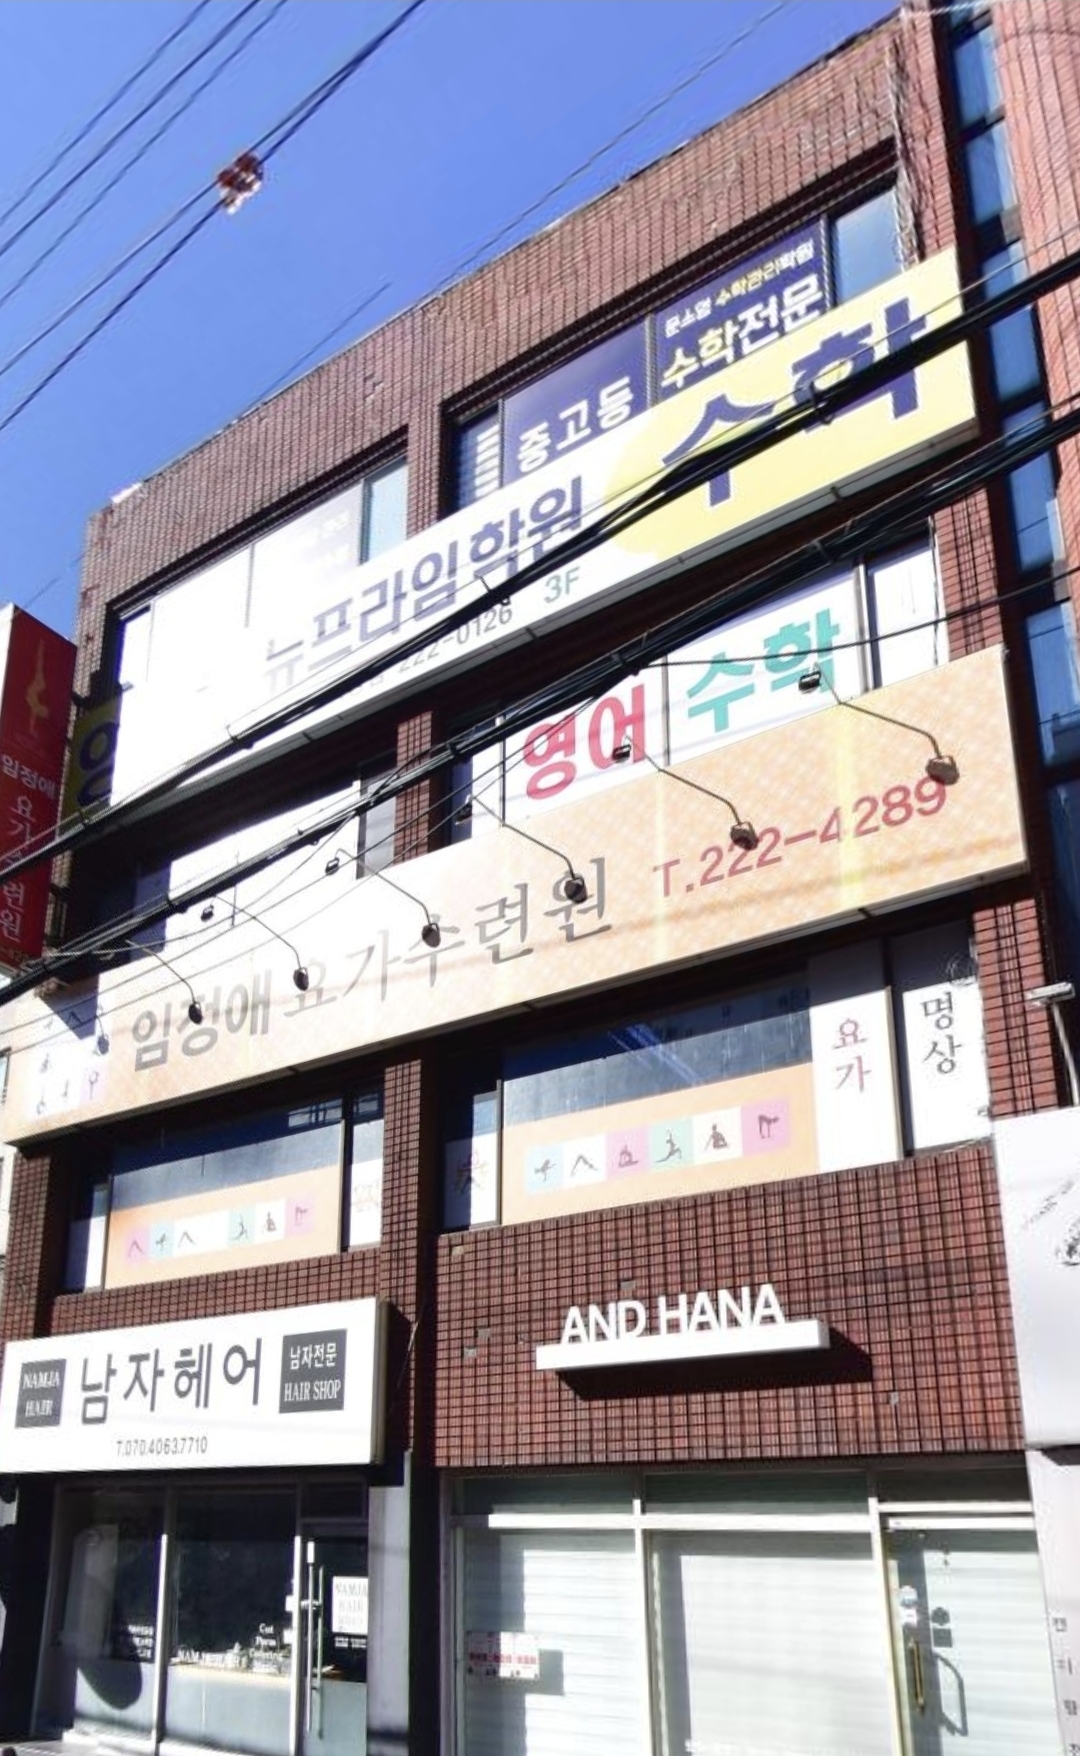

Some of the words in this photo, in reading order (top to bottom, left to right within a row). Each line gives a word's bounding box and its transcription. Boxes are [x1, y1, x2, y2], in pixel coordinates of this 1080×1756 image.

[517, 375, 633, 475] 중고등
[661, 273, 826, 388] 수학전문
[264, 475, 583, 694] 뉴프라임학원
[661, 296, 928, 508] 수학
[543, 566, 581, 604] 3F
[522, 684, 646, 801] 영어
[686, 607, 840, 733] 수학
[131, 966, 273, 1072] 임정애
[284, 856, 613, 1018] 요가수련원
[652, 776, 948, 898] T.222-4289
[833, 1018, 872, 1093] 요가
[919, 992, 963, 1075] 명상
[559, 1298, 648, 1345] AND
[659, 1282, 786, 1337] HANA
[22, 1371, 61, 1390] NAMJA
[80, 1337, 263, 1425] 남자헤어
[284, 1381, 311, 1402] HAIR
[312, 1379, 342, 1401] SHOP
[289, 1342, 338, 1370] 남자전문
[25, 1399, 54, 1417] HAIR
